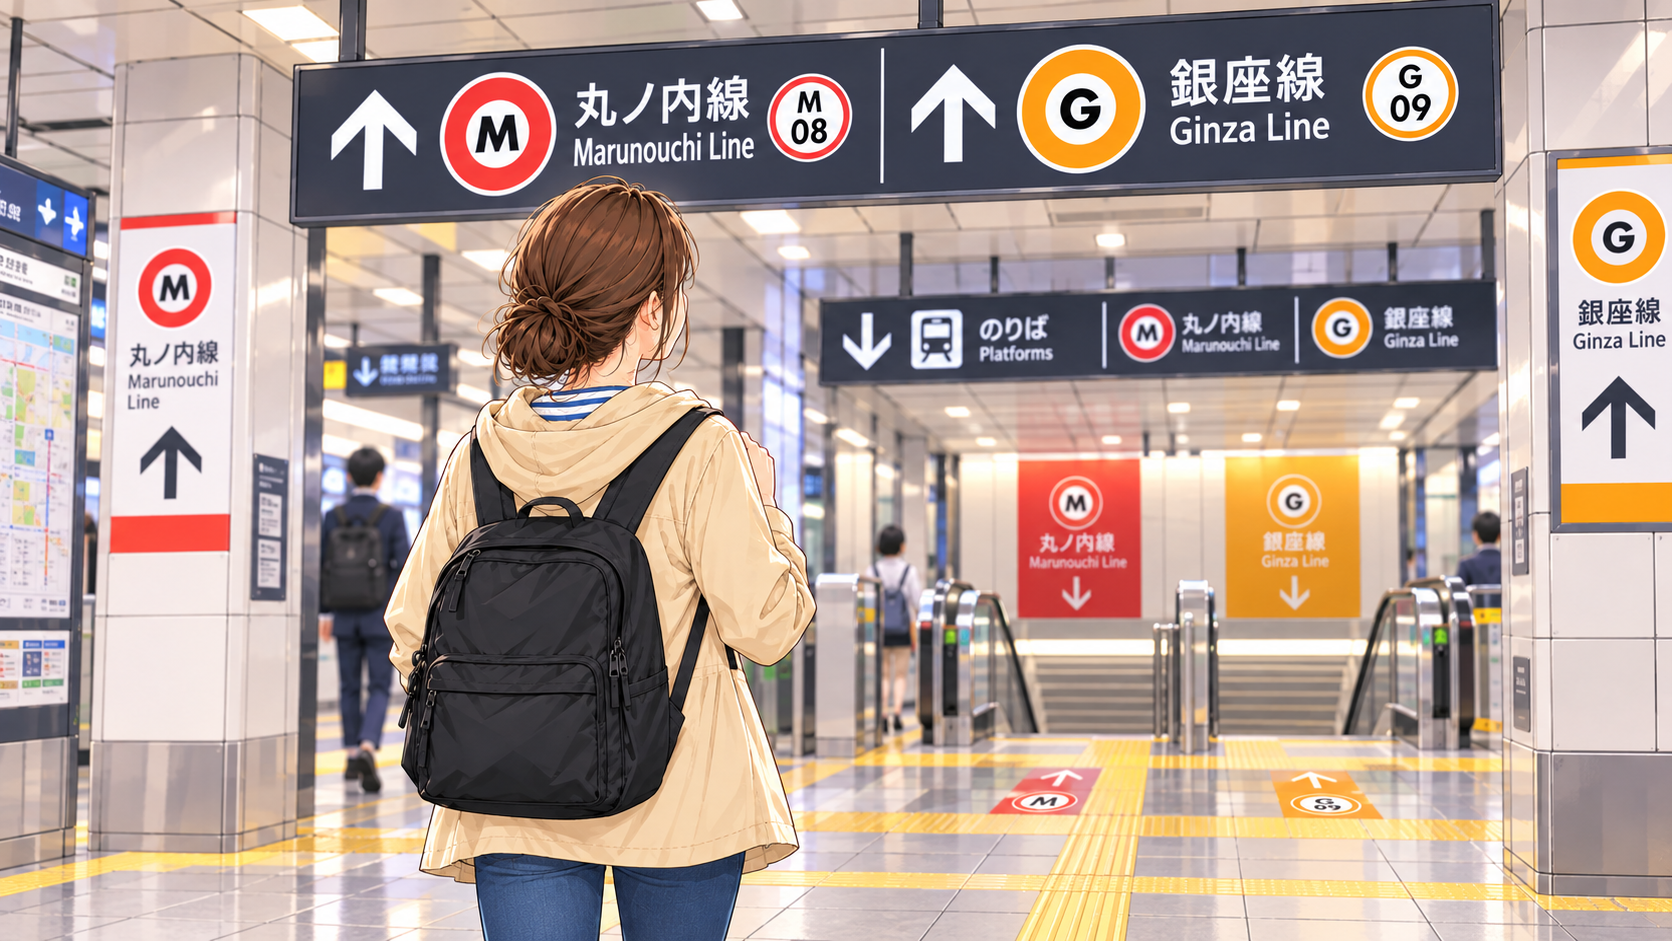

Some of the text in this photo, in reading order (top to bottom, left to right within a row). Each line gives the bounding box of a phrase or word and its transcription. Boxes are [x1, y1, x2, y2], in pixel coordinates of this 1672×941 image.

[1170, 53, 1324, 106] 銀座線
[1399, 65, 1422, 89] G
[575, 75, 749, 128] 丸ノ内線
[798, 91, 821, 113] M
[1060, 88, 1101, 129] G
[1391, 94, 1431, 122] 09
[475, 115, 519, 153] M
[791, 118, 827, 146] 08
[1171, 112, 1329, 145] Ginza Line
[574, 131, 754, 166] Marunouchi Line
[1603, 221, 1635, 254] G
[159, 274, 190, 302] M
[1183, 311, 1261, 334] 丸ノ内線
[1385, 306, 1452, 329] 銀座線
[1578, 297, 1661, 326] 銀座線
[980, 314, 1050, 341] のりば
[1137, 324, 1157, 341] M
[1333, 318, 1351, 337] G
[1183, 334, 1281, 353] Marunouchi Line
[1384, 332, 1458, 348] Ginza Line
[1573, 331, 1665, 349] Ginza Line
[129, 340, 219, 368] 丸ノ内線
[980, 346, 1053, 361] Platforms
[129, 371, 218, 389] Marunouchi
[128, 395, 159, 409] Line
[1066, 495, 1086, 511] M
[1286, 493, 1303, 510] G
[1040, 533, 1114, 552] 丸ノ内線
[1264, 532, 1325, 551] 銀座線
[1030, 555, 1127, 568] Marunouchi Line
[1262, 555, 1329, 567] Ginza Line
[1029, 797, 1058, 807] M
